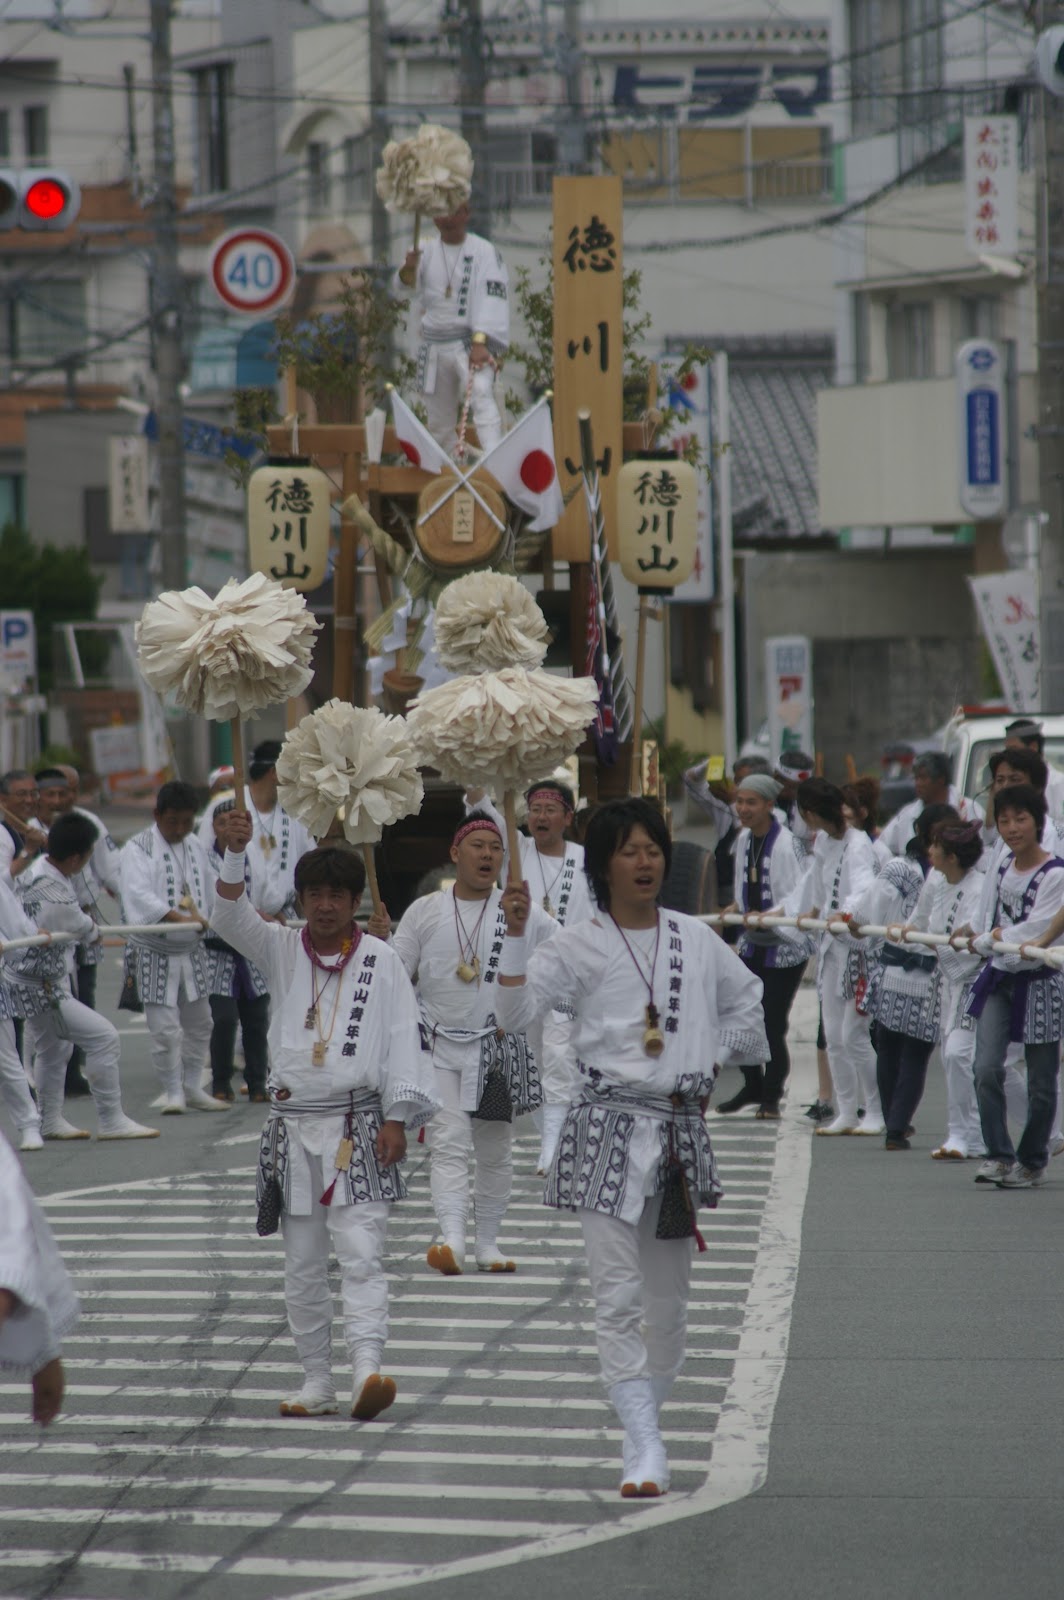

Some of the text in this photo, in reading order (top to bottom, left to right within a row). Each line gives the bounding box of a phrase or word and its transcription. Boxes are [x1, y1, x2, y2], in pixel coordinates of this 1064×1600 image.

[228, 253, 274, 289] 40
[265, 477, 314, 580] 徳川山
[634, 469, 682, 573] 徳川山
[4, 618, 29, 648] P
[484, 901, 507, 984] 川山青年部
[665, 919, 684, 1034] 徳川山青年部
[341, 954, 378, 1057] 徳川山青年部
